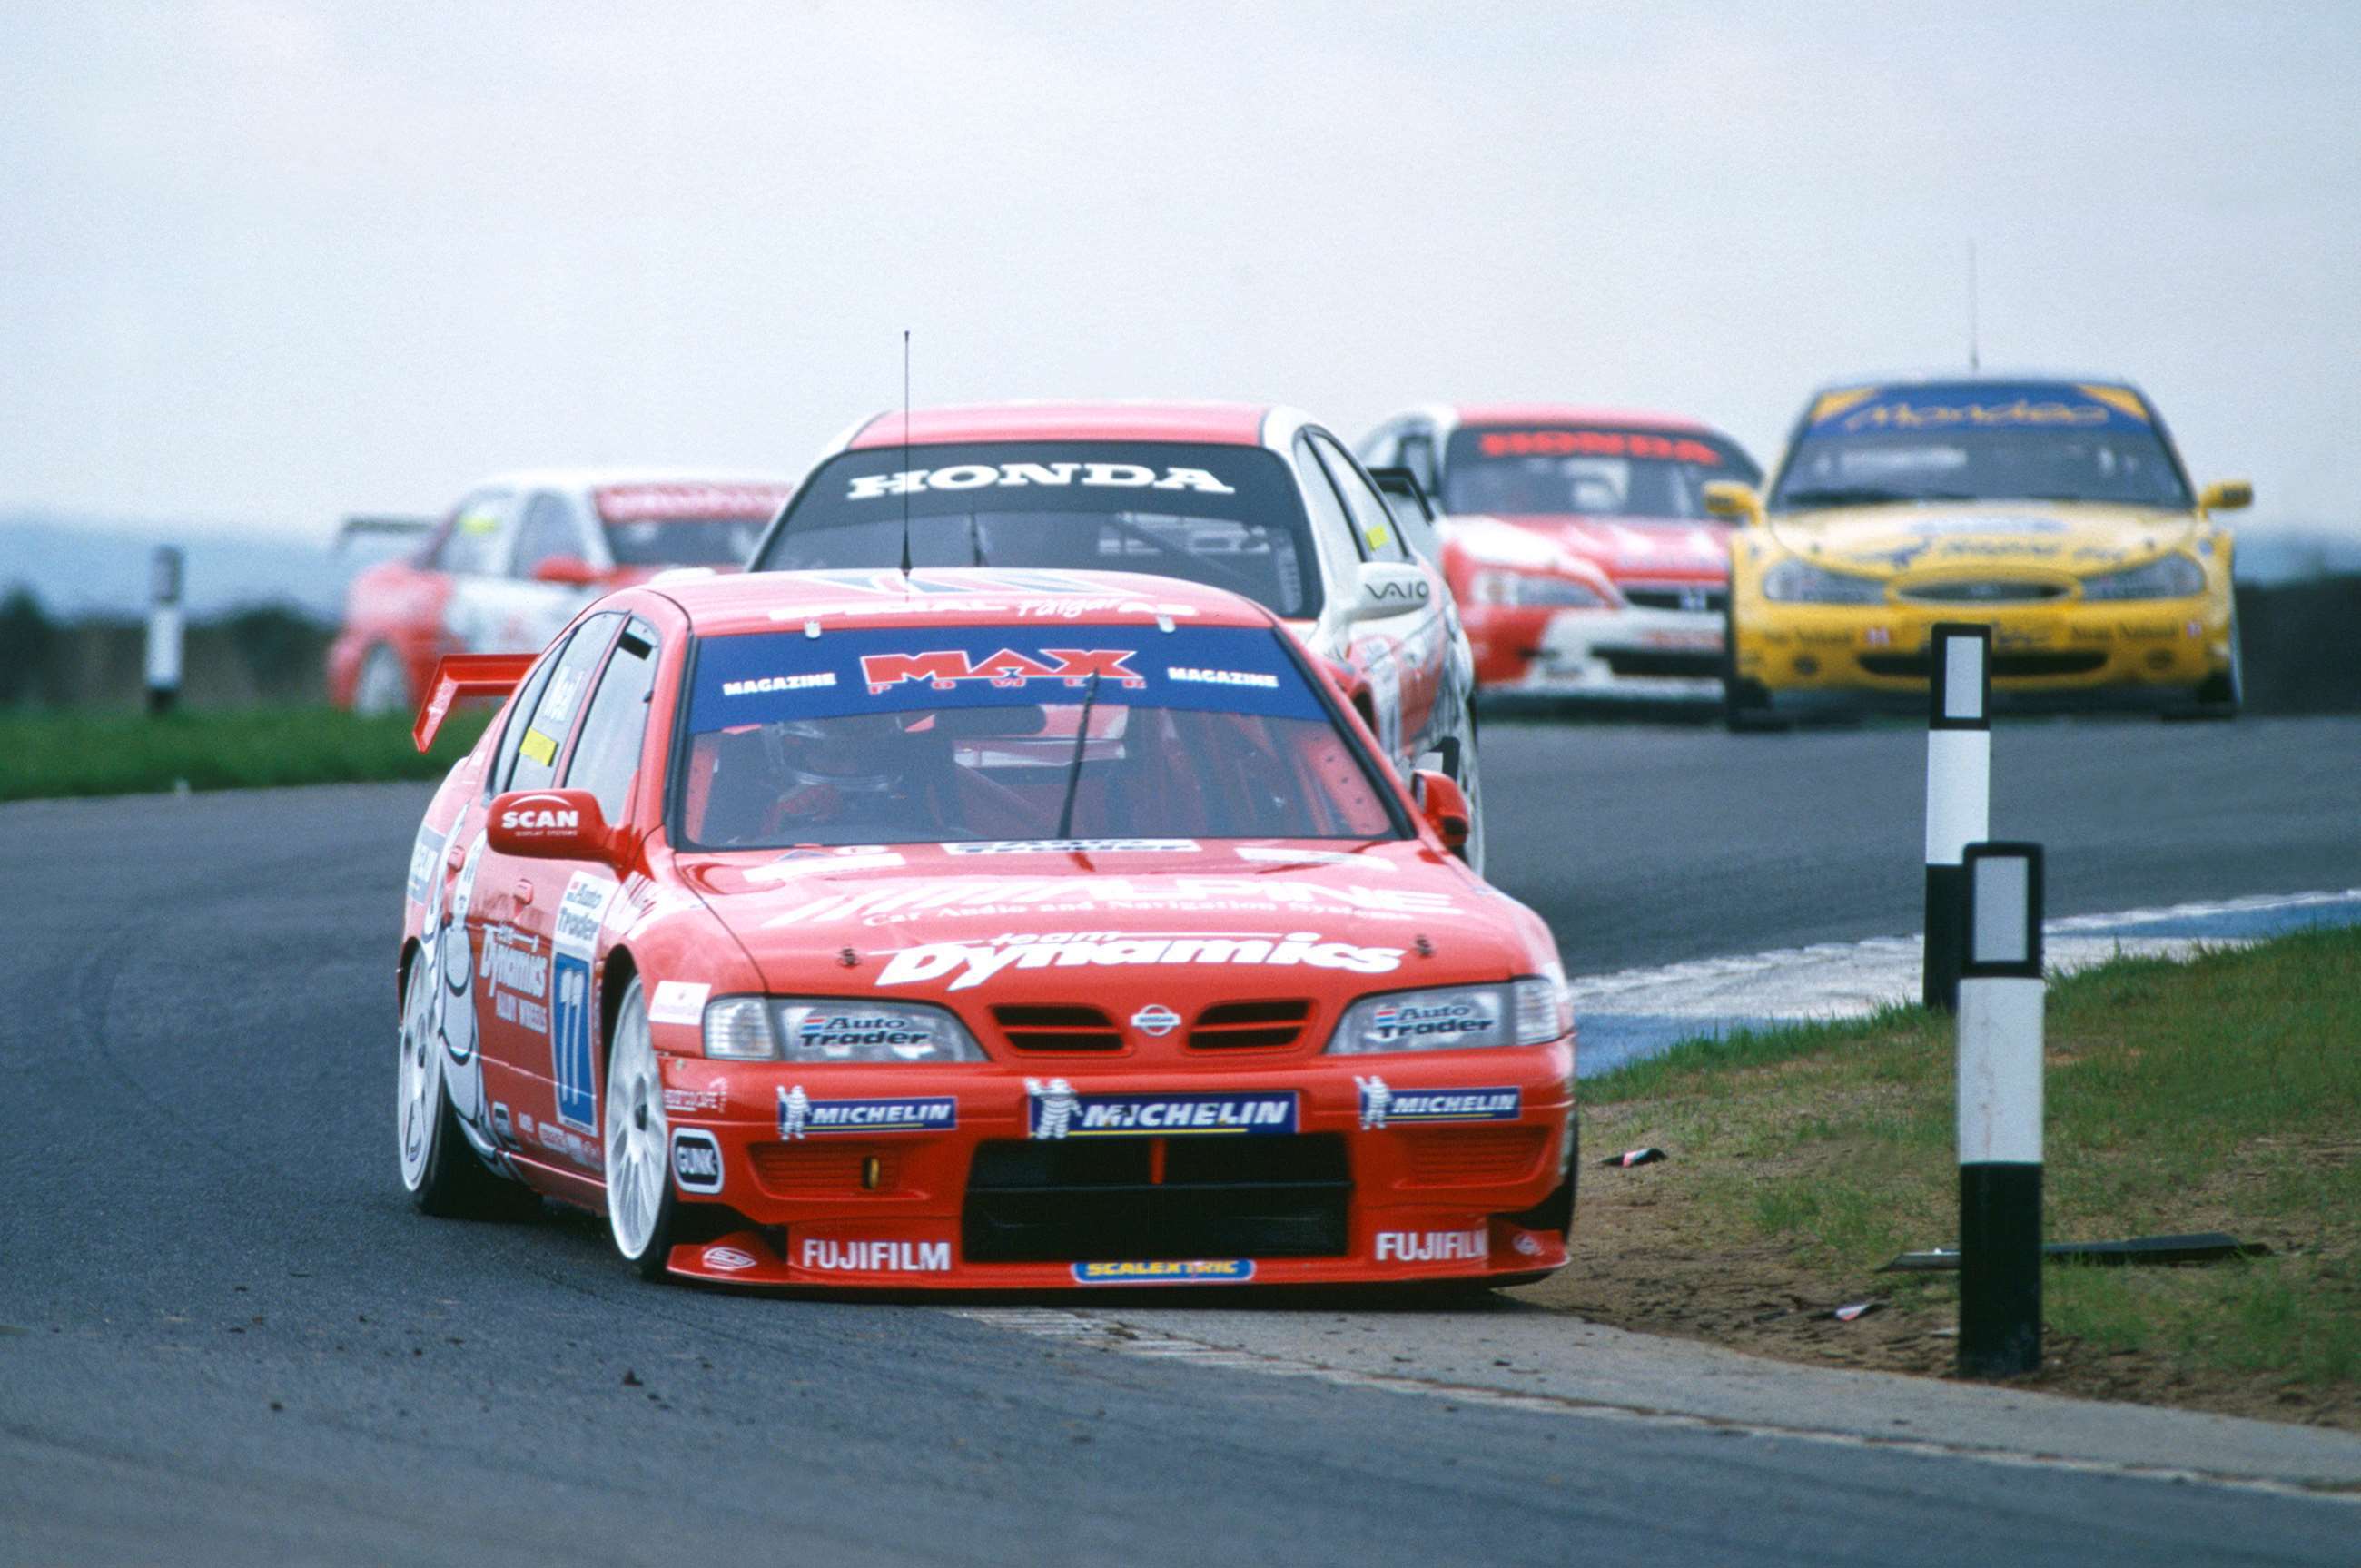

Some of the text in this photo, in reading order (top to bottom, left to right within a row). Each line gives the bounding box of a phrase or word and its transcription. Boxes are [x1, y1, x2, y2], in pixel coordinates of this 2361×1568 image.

[847, 462, 1236, 500] HONDA
[1364, 580, 1430, 600] VAIO
[723, 646, 1279, 696] MAGAZINE MAX MAGAZINE
[501, 810, 579, 829] SCAN
[863, 911, 921, 927] Car
[935, 903, 1027, 919] Audio
[1038, 900, 1095, 913] and
[989, 931, 1122, 946] team
[874, 932, 1408, 991] Dynamics
[1398, 1004, 1470, 1021] Auto
[825, 1016, 906, 1031] Auto
[1378, 1018, 1496, 1039] Trader
[560, 966, 586, 1106] 11
[800, 1030, 932, 1047] Trader
[1391, 1093, 1518, 1113] MICHELIN
[811, 1104, 953, 1124] MICHELIN
[1082, 1100, 1289, 1128] MICHELIN
[802, 1238, 951, 1271] FUJIFILM
